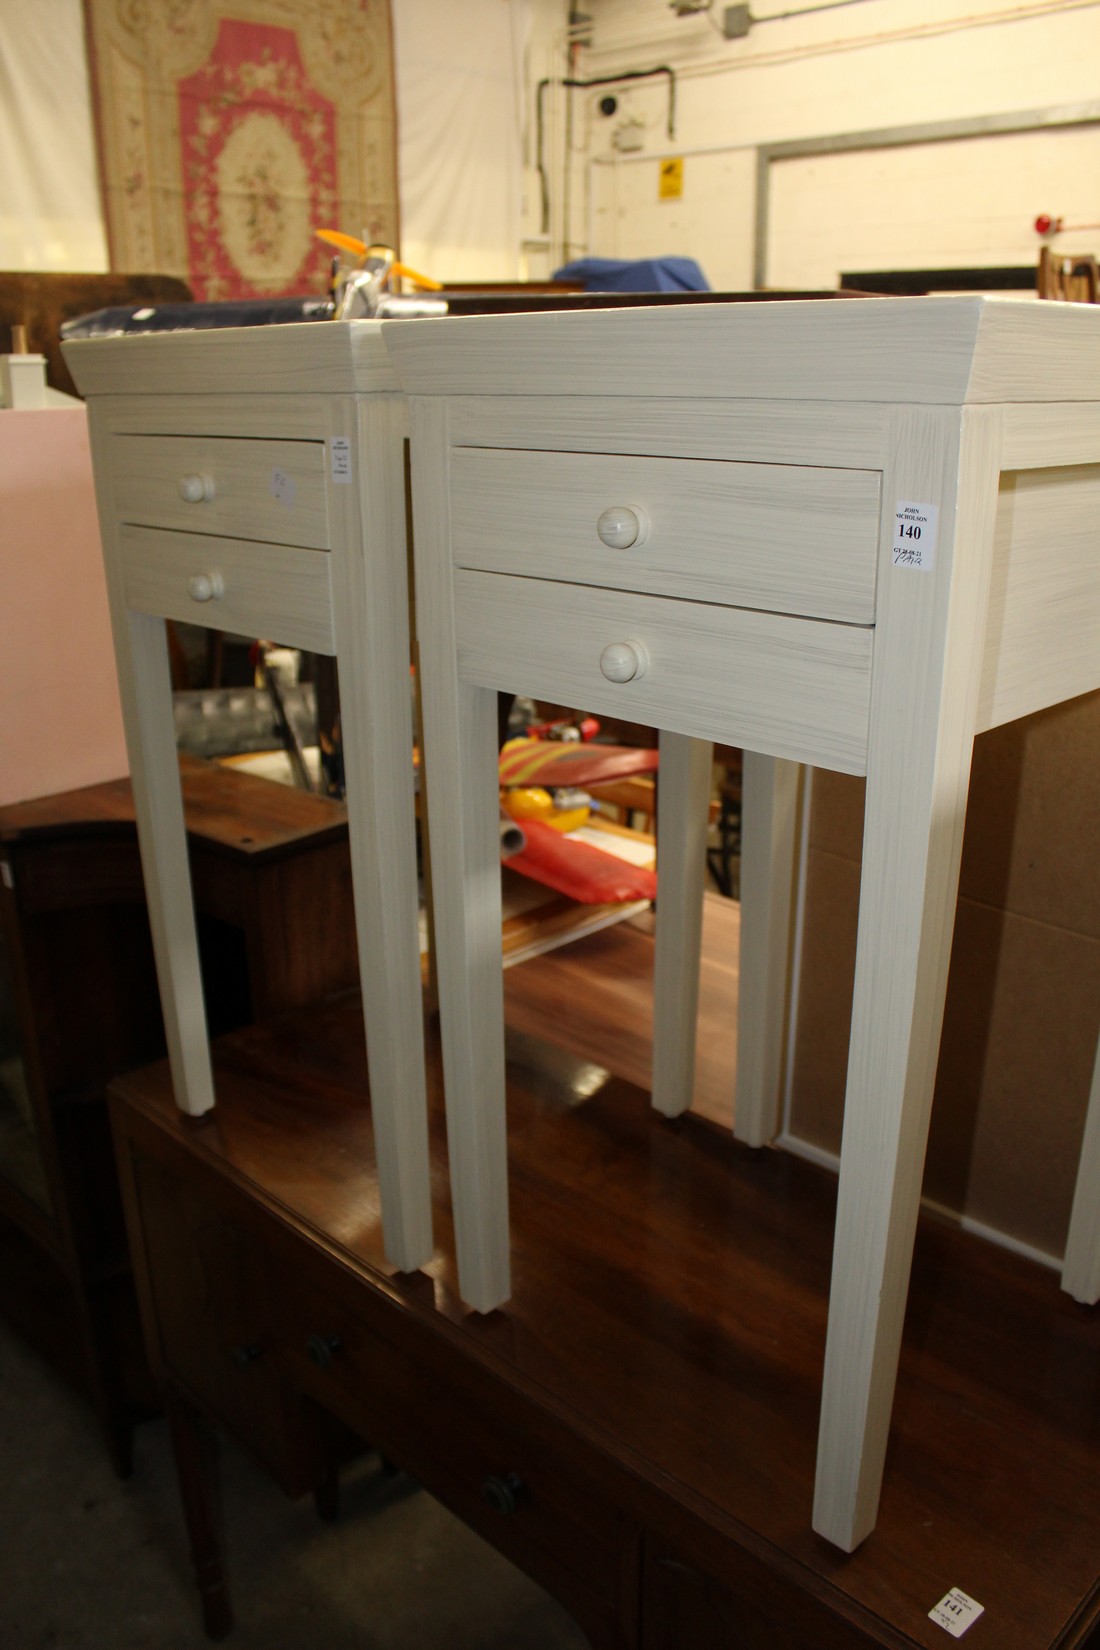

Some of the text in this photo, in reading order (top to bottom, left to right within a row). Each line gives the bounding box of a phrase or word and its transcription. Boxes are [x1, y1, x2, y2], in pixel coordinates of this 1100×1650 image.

[896, 513, 928, 522] NICHOLSON
[899, 524, 922, 540] 140
[944, 1600, 963, 1615] 141
